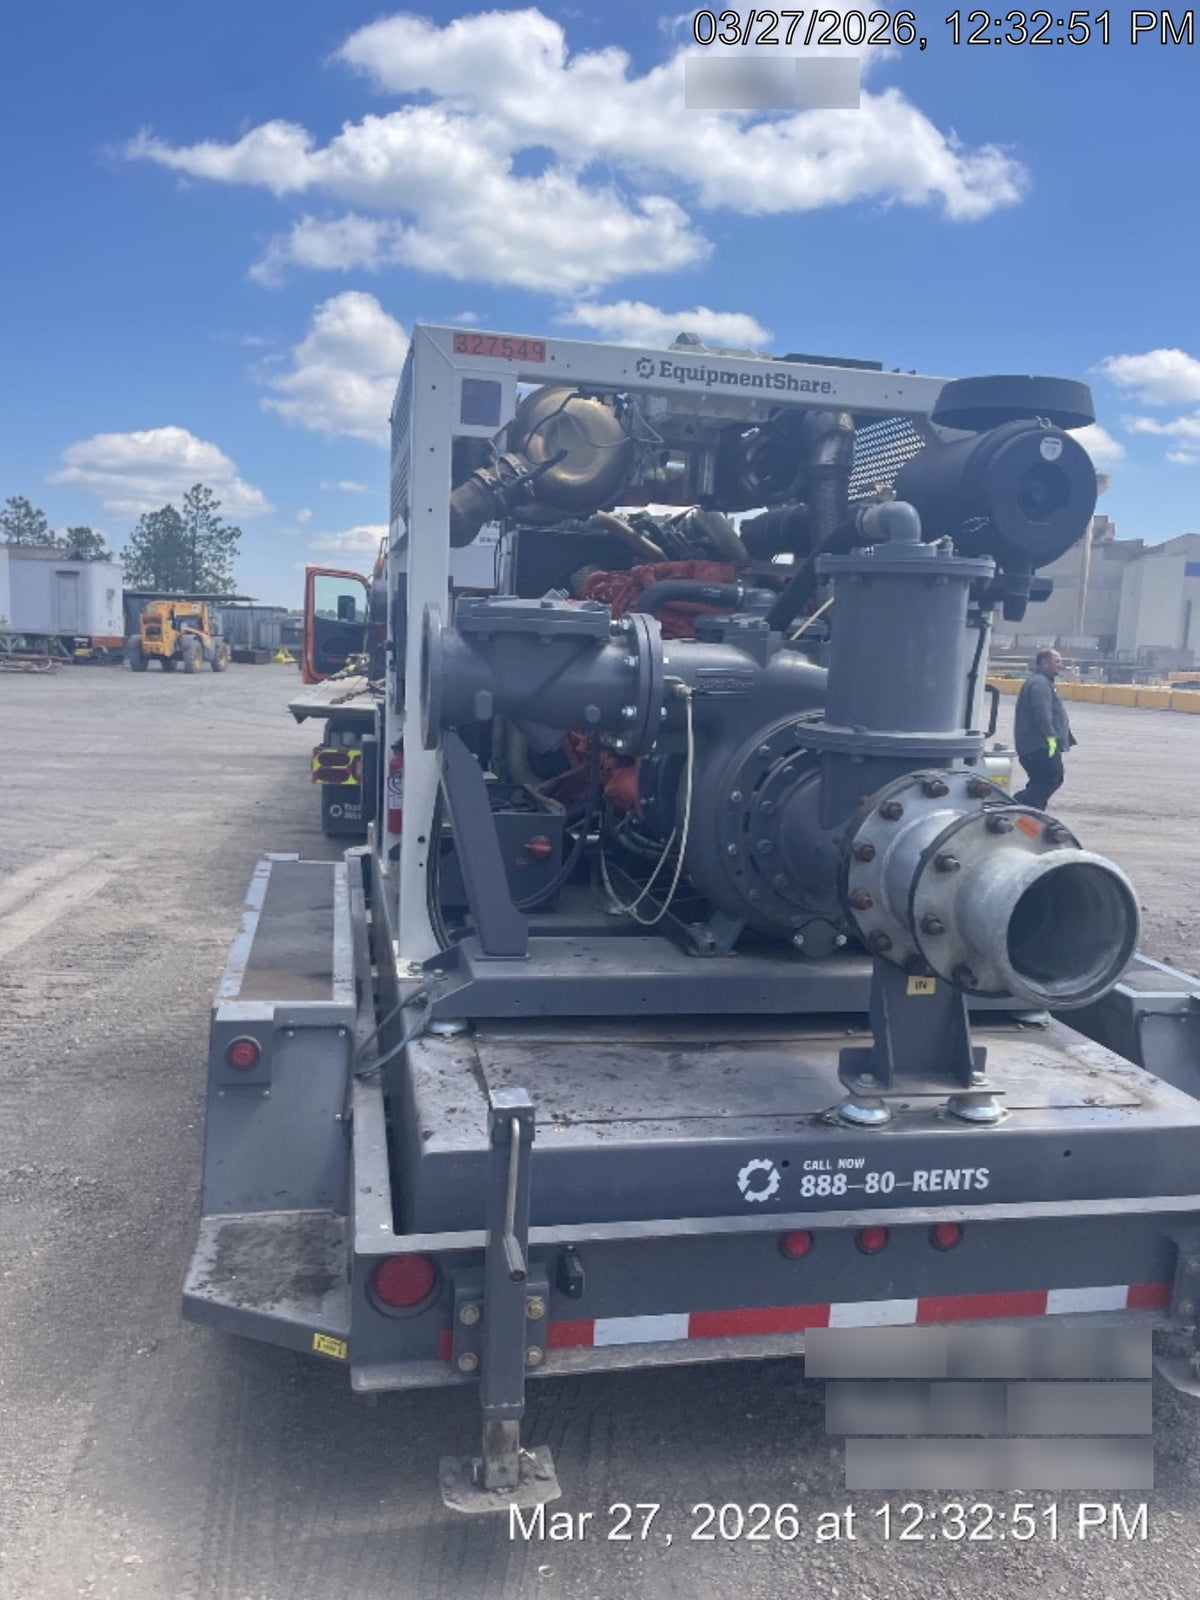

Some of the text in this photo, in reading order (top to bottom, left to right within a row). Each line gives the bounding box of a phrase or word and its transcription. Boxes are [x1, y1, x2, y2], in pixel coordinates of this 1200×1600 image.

[454, 334, 544, 361] 327549
[803, 1158, 865, 1171] CALL NOW
